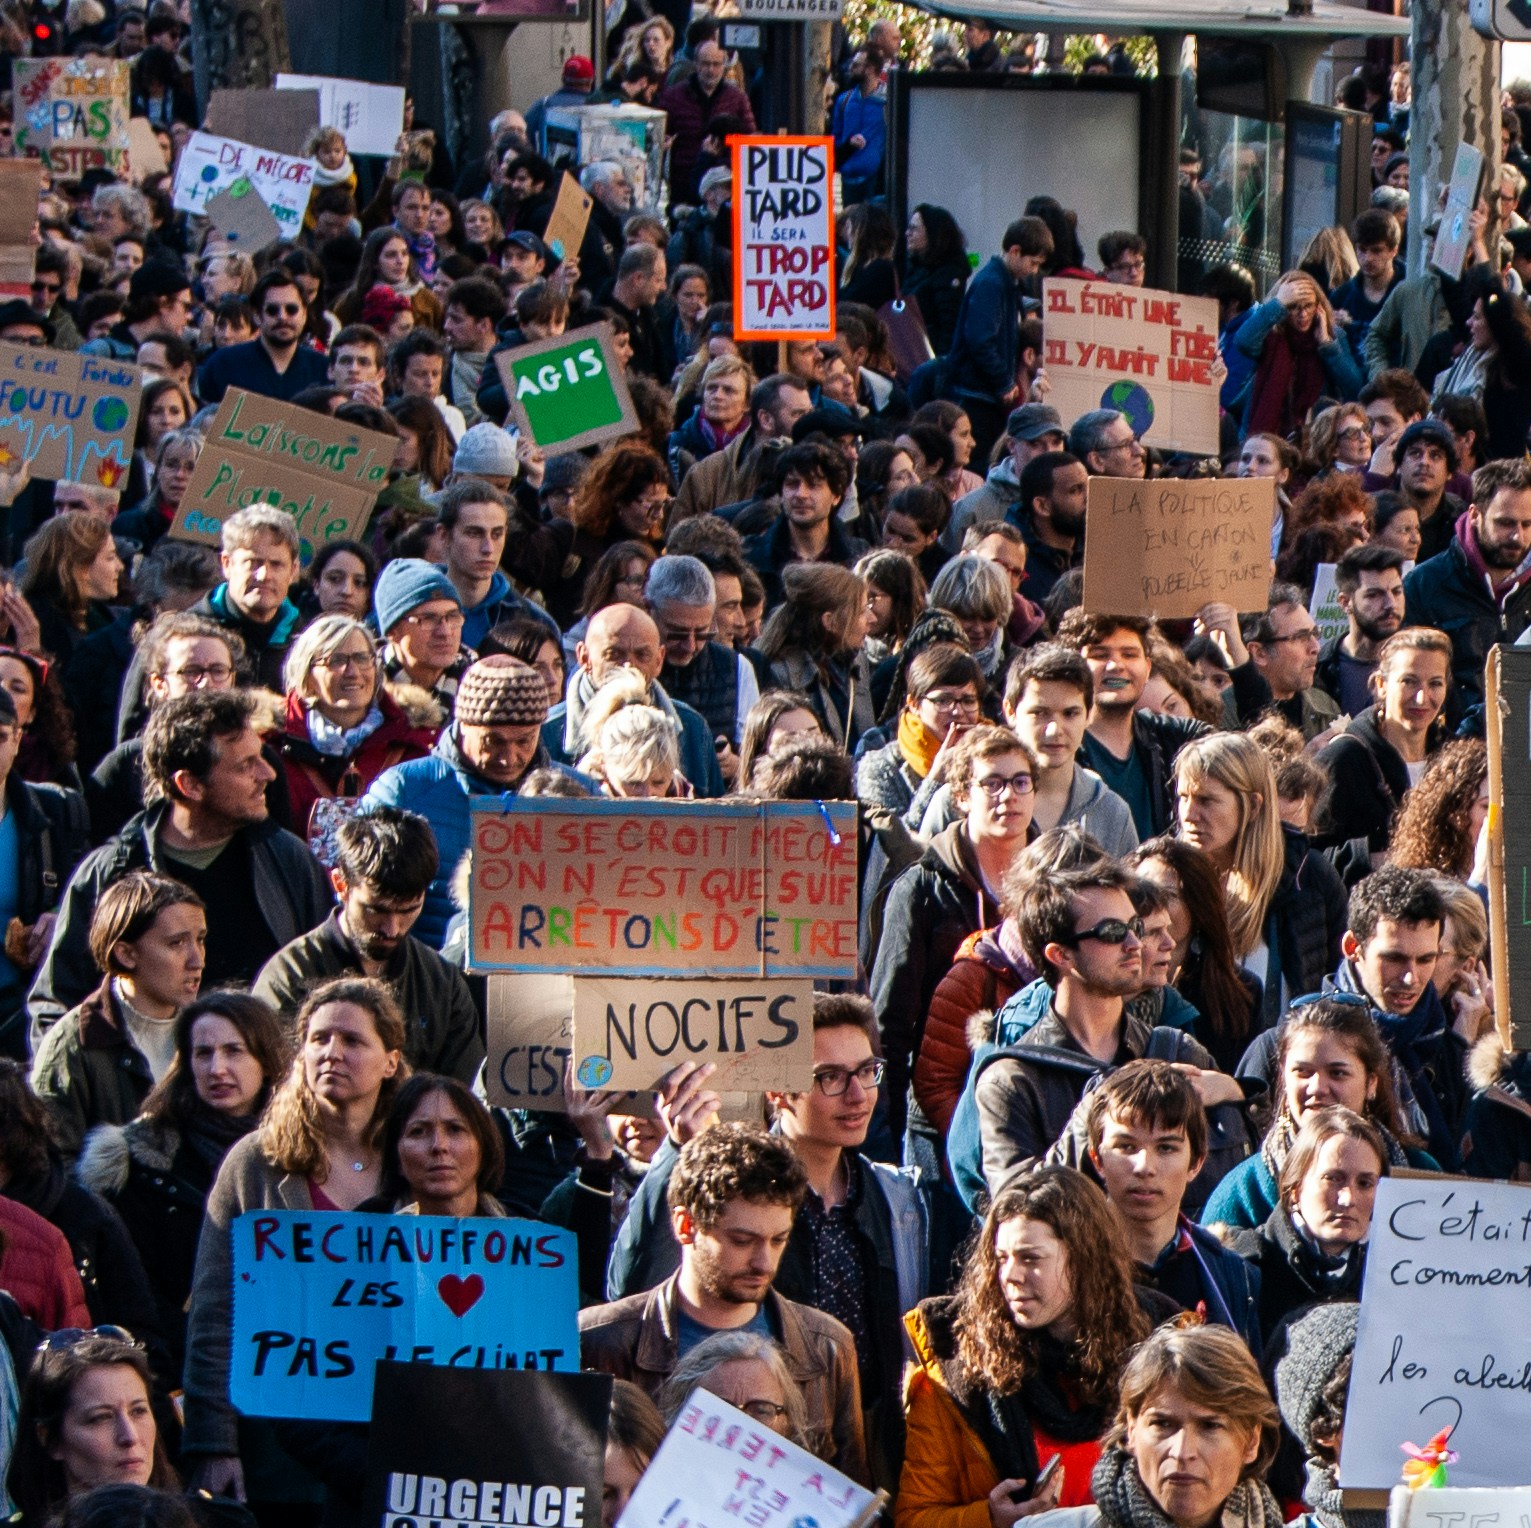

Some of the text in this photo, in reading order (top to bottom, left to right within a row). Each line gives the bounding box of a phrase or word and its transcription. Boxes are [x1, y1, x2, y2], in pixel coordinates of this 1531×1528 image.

[53, 100, 112, 141] PAS
[747, 145, 827, 188] PLUS
[745, 188, 823, 229] TARD
[770, 227, 807, 241] SERA
[746, 243, 830, 276] TROP
[746, 279, 828, 318] TARD
[1047, 289, 1076, 314] IL
[1143, 299, 1183, 327] UNE
[515, 347, 604, 401] AGIS
[1076, 341, 1097, 367] Y
[1167, 357, 1213, 385] UNE
[1111, 490, 1255, 518] LA POLITIQUE
[1144, 527, 1179, 553] EN
[479, 818, 546, 855] ON
[556, 823, 612, 857] SE
[613, 822, 738, 857] CROIT
[479, 857, 858, 906] ON N'EST QUE SUIF
[483, 898, 720, 953] ARRÊTONS
[604, 993, 800, 1061] NOCIFS
[252, 1216, 568, 1270] RECHAUFFONS
[330, 1277, 405, 1309] LES
[249, 1329, 358, 1380] PAS
[1378, 1333, 1429, 1386] les
[387, 1472, 587, 1528] URGENCE
